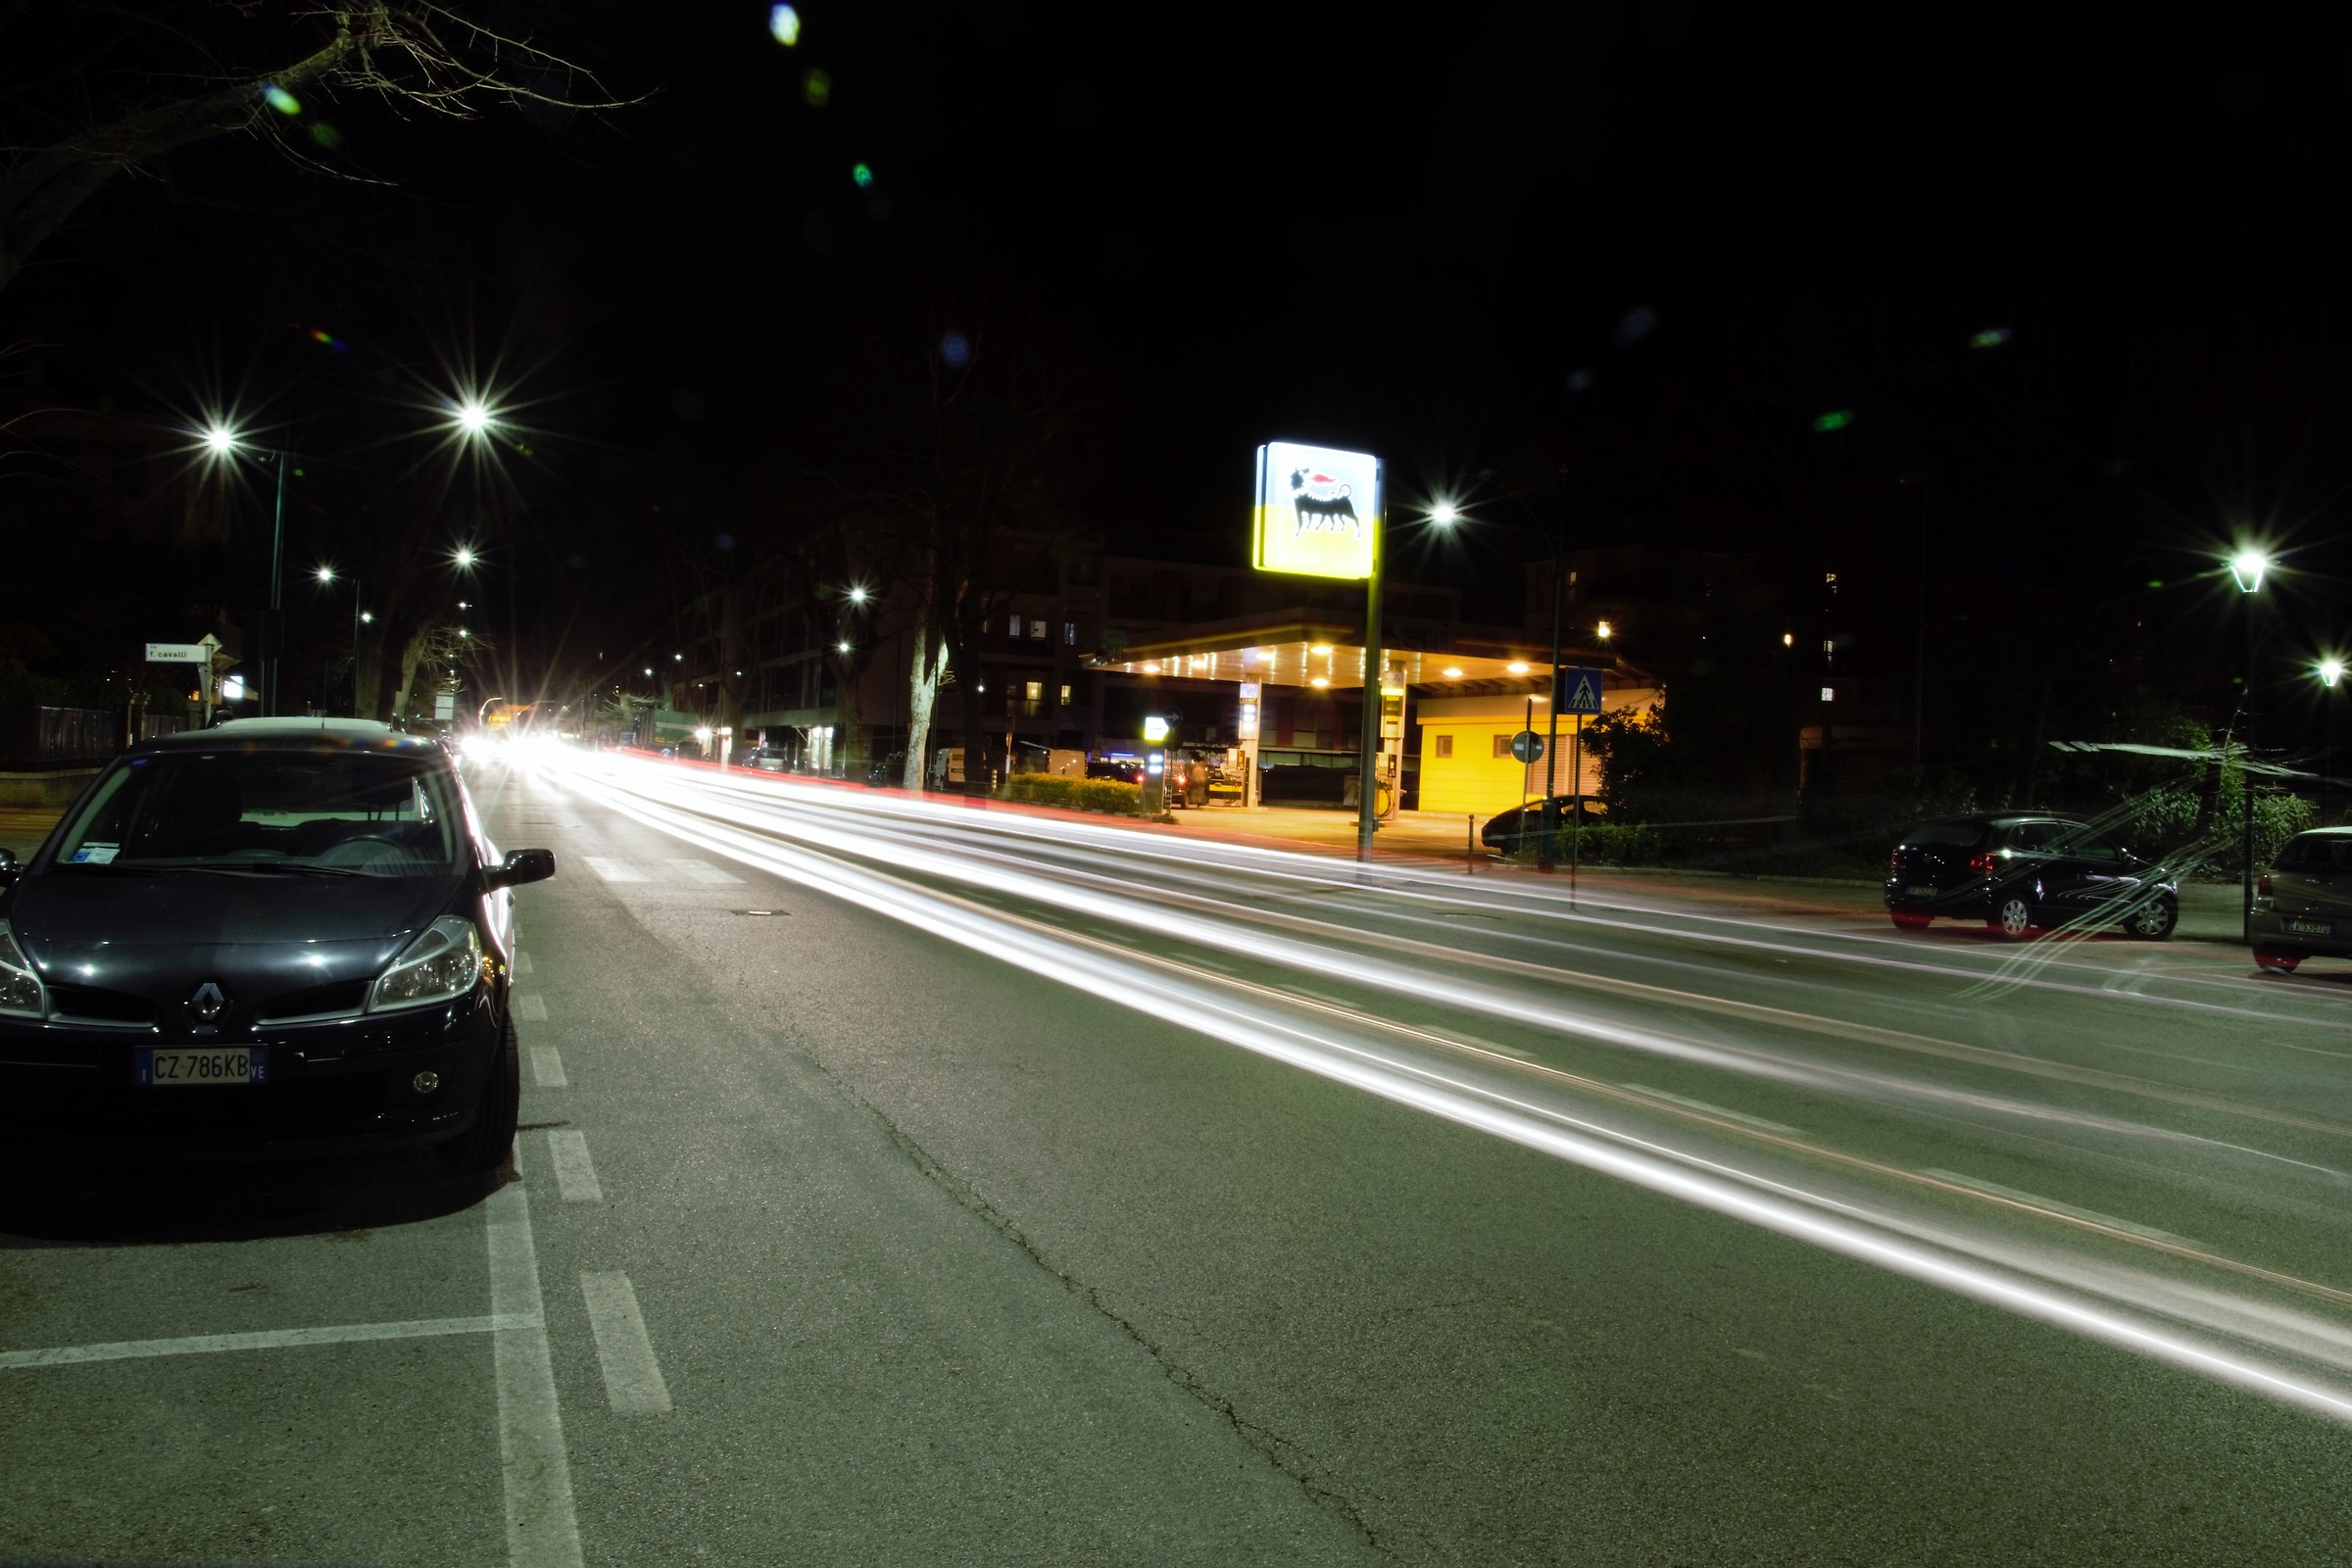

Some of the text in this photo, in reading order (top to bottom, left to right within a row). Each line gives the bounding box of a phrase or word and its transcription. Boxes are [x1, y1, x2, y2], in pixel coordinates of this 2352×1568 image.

[1402, 622, 1448, 653] eni
[154, 1055, 179, 1079] CZ
[186, 1054, 249, 1078] 786KB
[250, 1066, 265, 1079] VE
